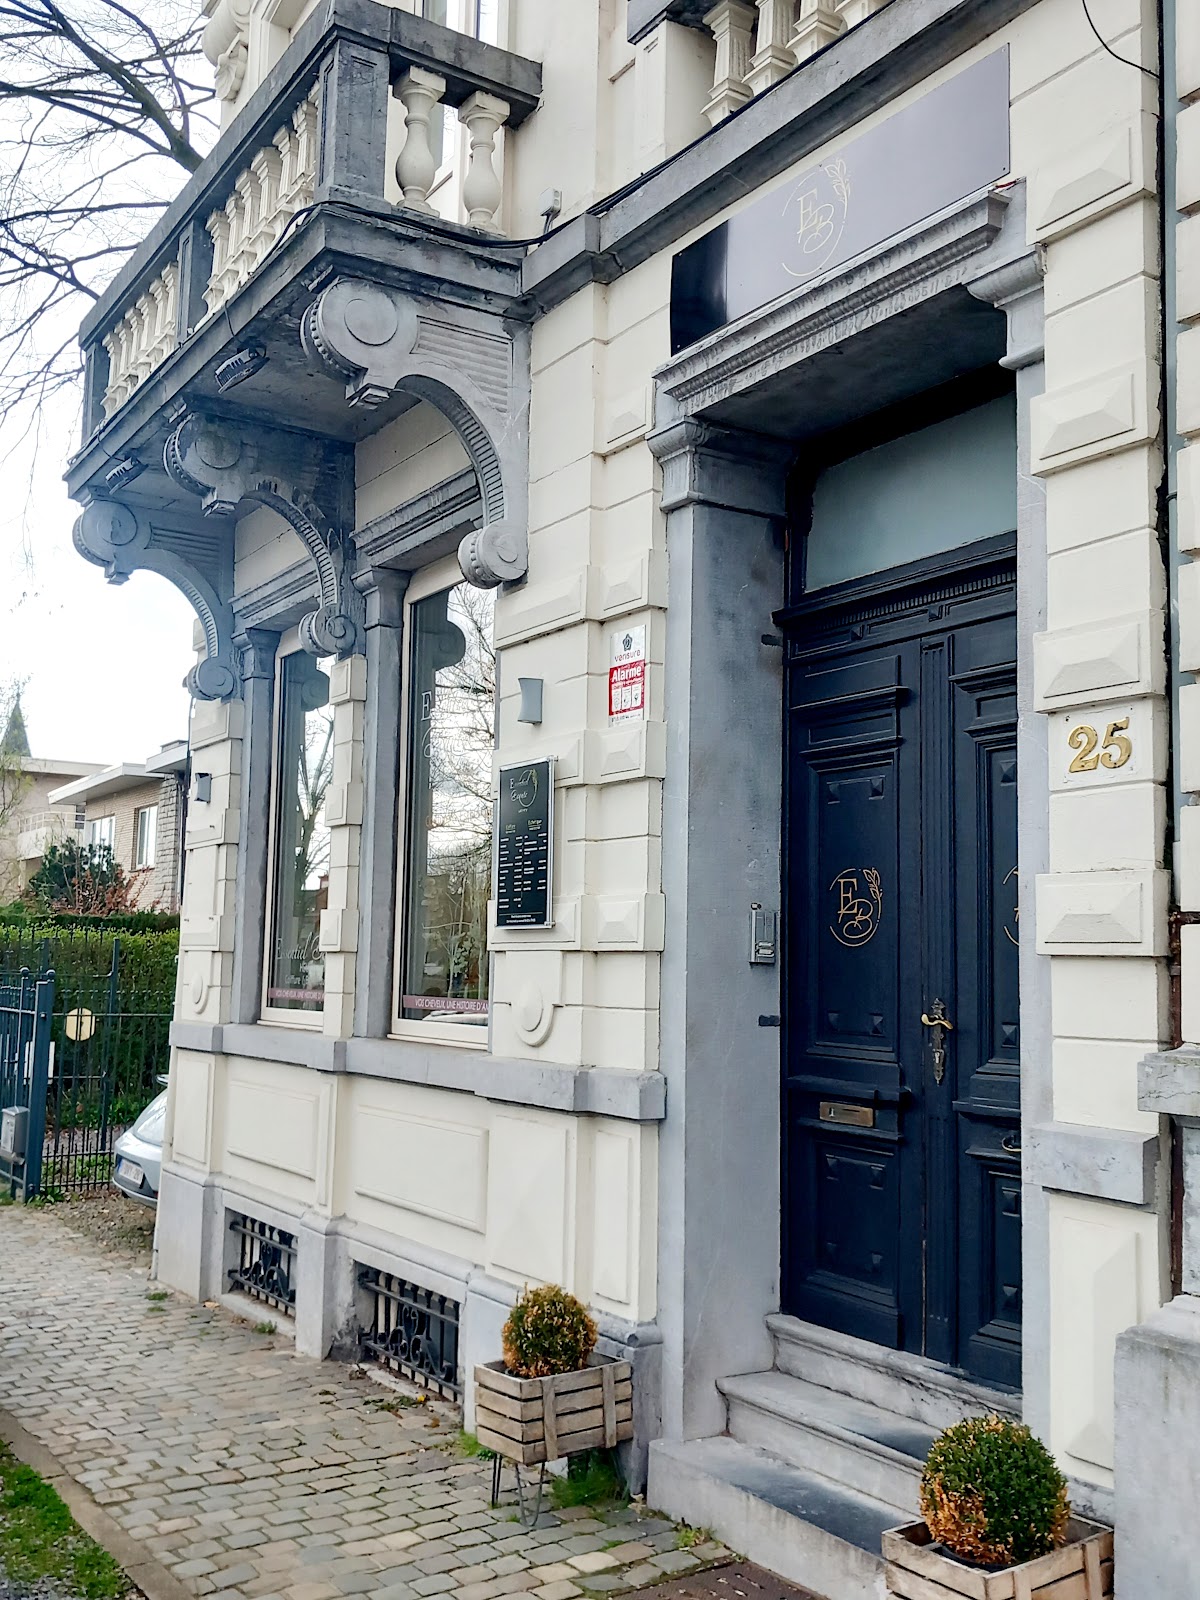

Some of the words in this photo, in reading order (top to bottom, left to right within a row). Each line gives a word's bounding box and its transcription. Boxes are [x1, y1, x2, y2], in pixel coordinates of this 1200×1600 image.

[614, 650, 641, 662] verisure
[612, 666, 642, 682] Alarme
[1067, 717, 1133, 773] 25
